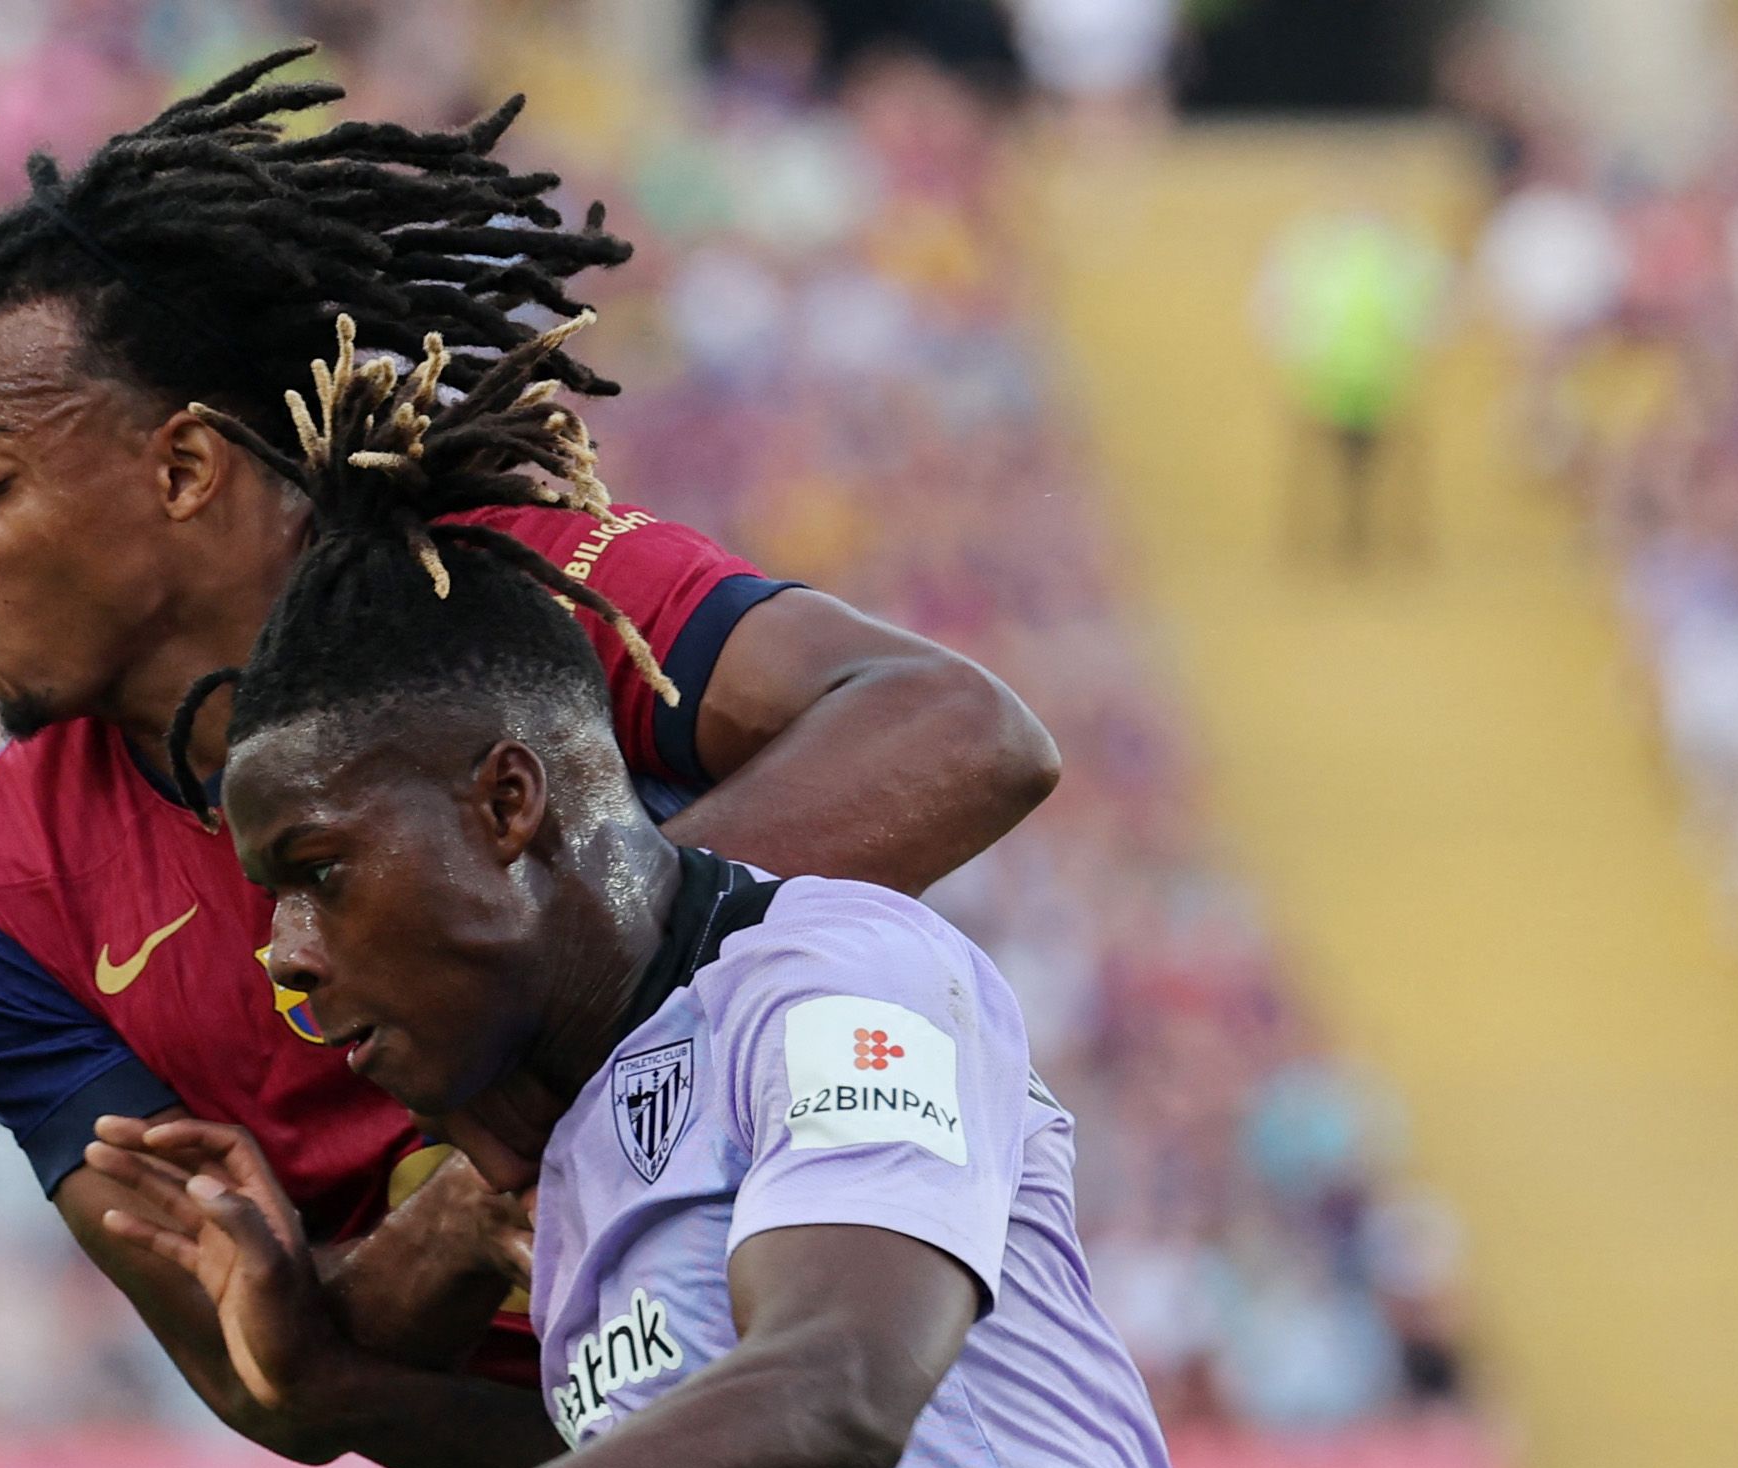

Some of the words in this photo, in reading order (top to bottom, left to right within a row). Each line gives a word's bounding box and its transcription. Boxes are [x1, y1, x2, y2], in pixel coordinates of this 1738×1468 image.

[619, 1054, 662, 1073] ATHLETIC
[663, 1046, 688, 1061] CLUB
[790, 1085, 958, 1133] B2BINPAY
[633, 1137, 670, 1178] BILBAO
